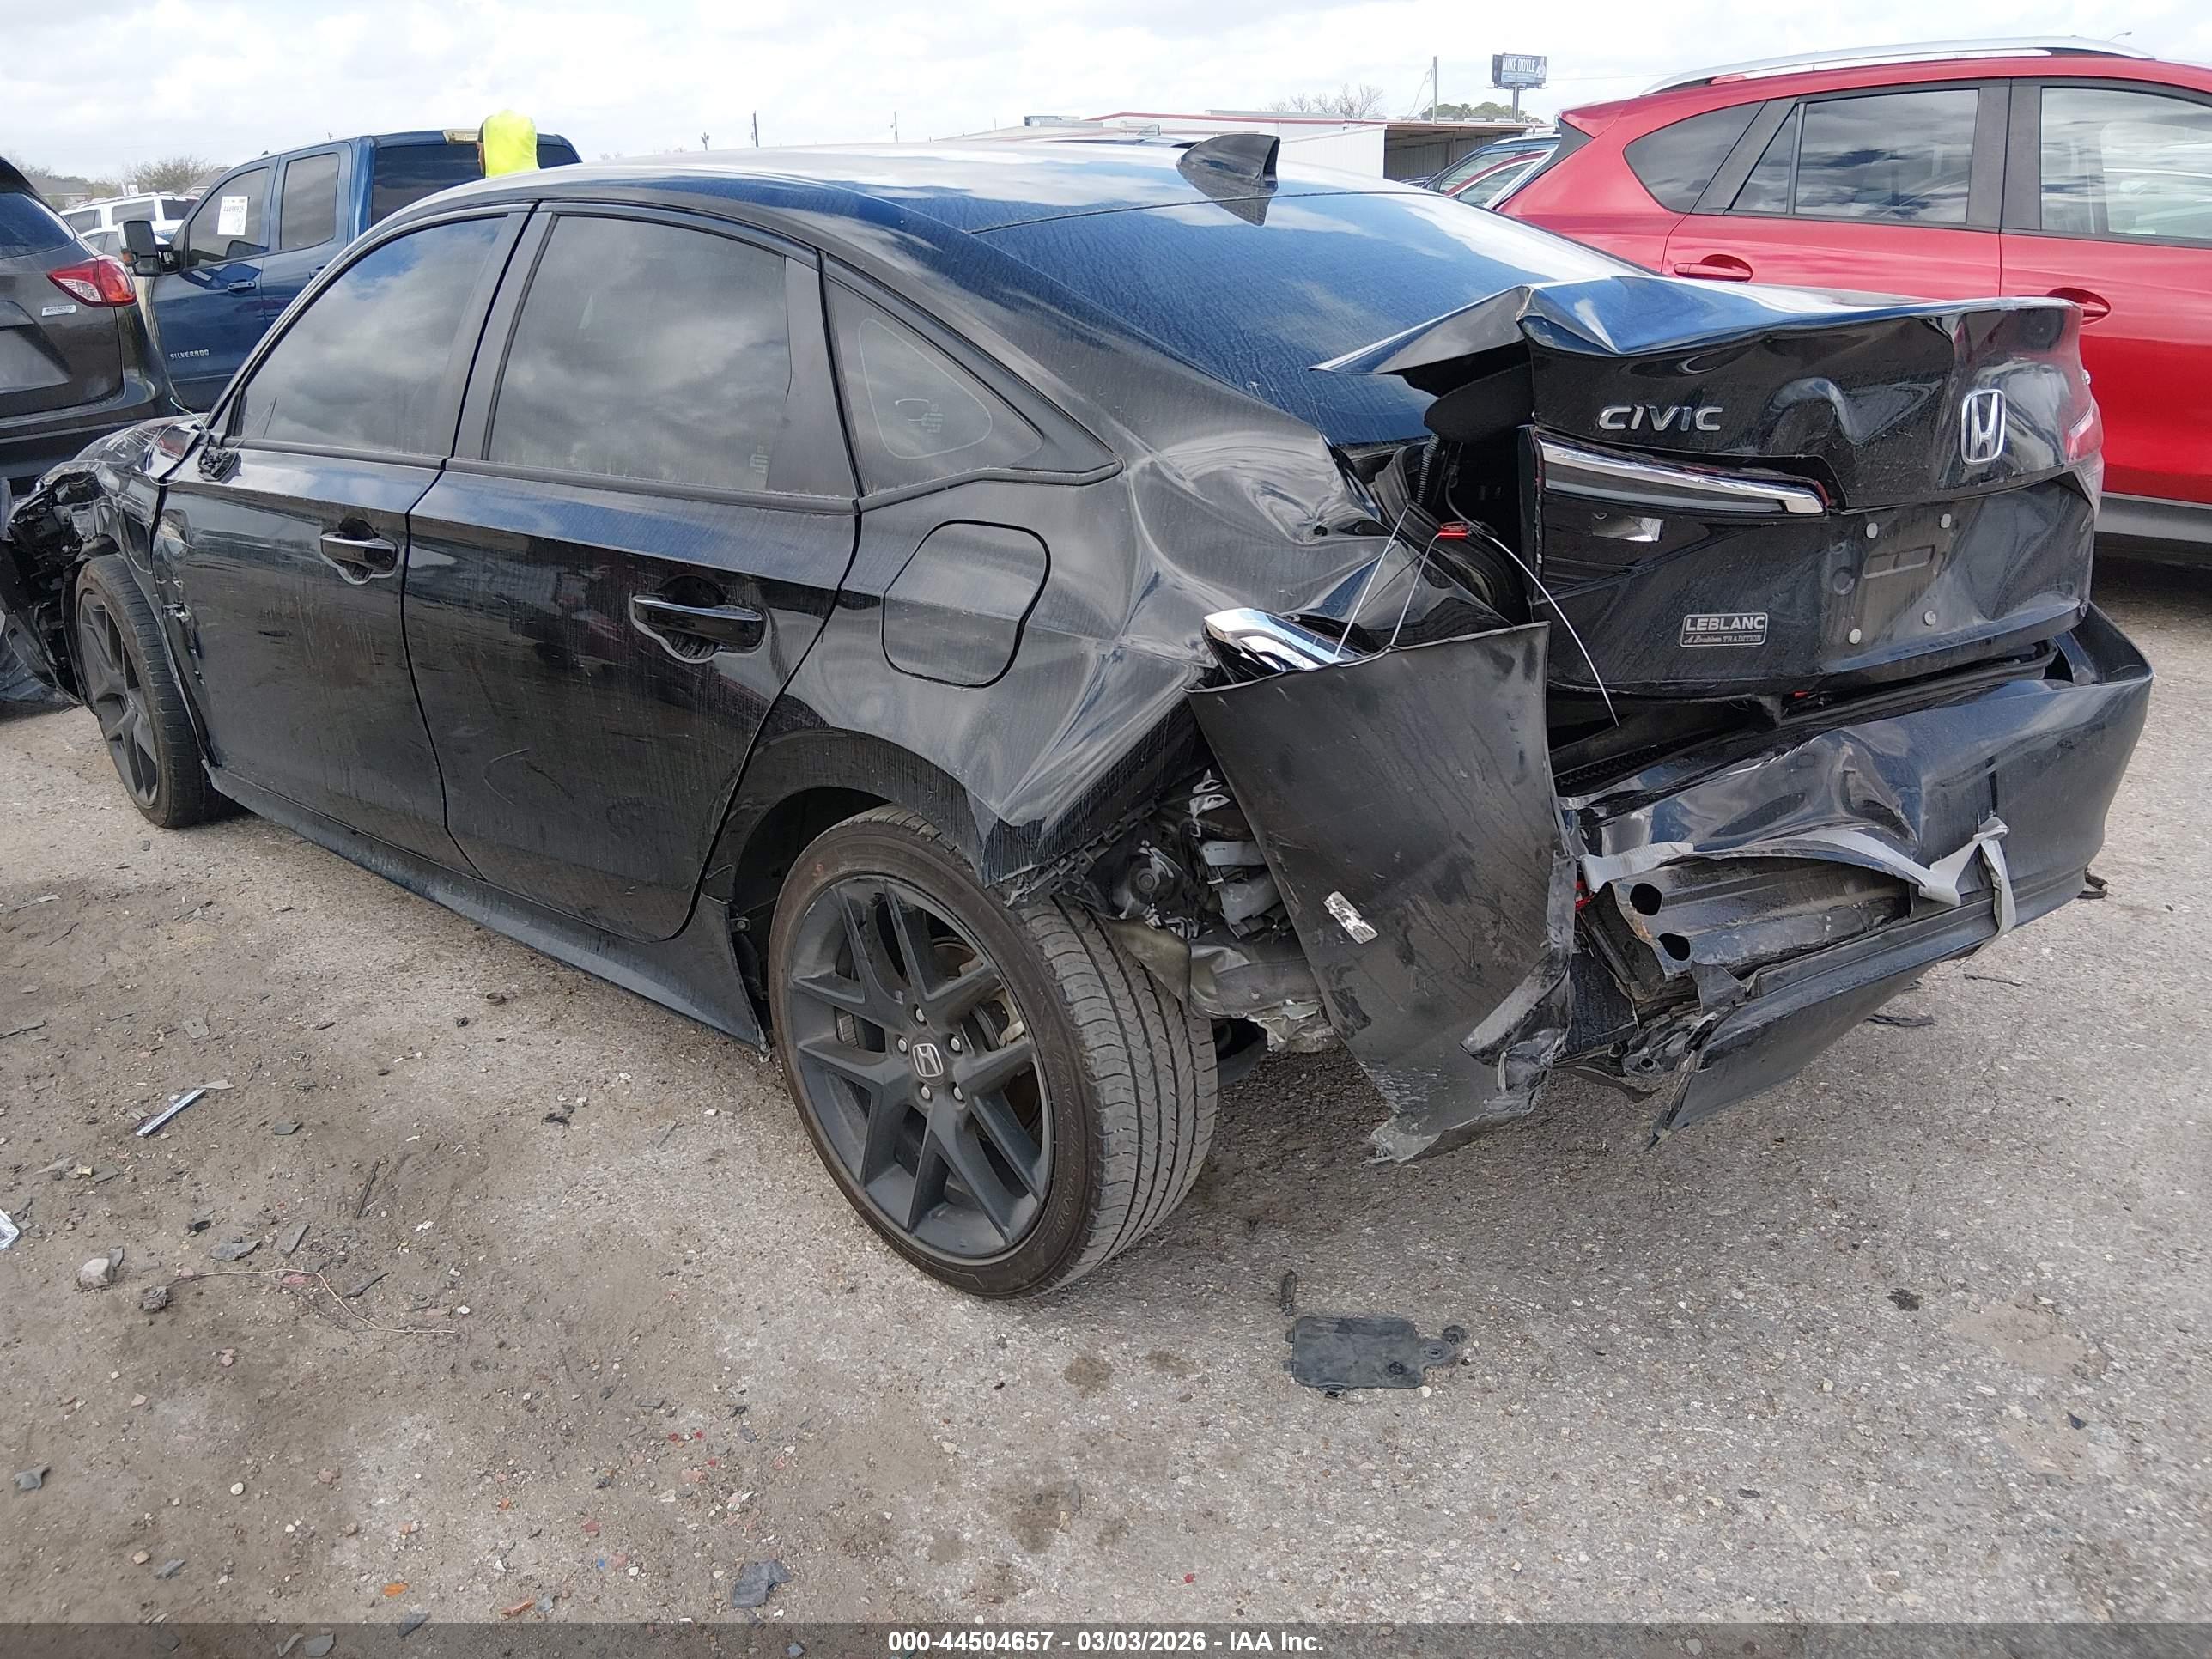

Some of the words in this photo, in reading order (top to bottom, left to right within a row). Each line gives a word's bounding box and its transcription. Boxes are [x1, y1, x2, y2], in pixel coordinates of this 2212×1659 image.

[1503, 58, 1516, 71] MIKE
[1517, 58, 1535, 73] DOYLE
[170, 349, 209, 359] SILVERADO
[1598, 405, 1723, 431] CIVIC
[1686, 617, 1765, 631] LEBLANC
